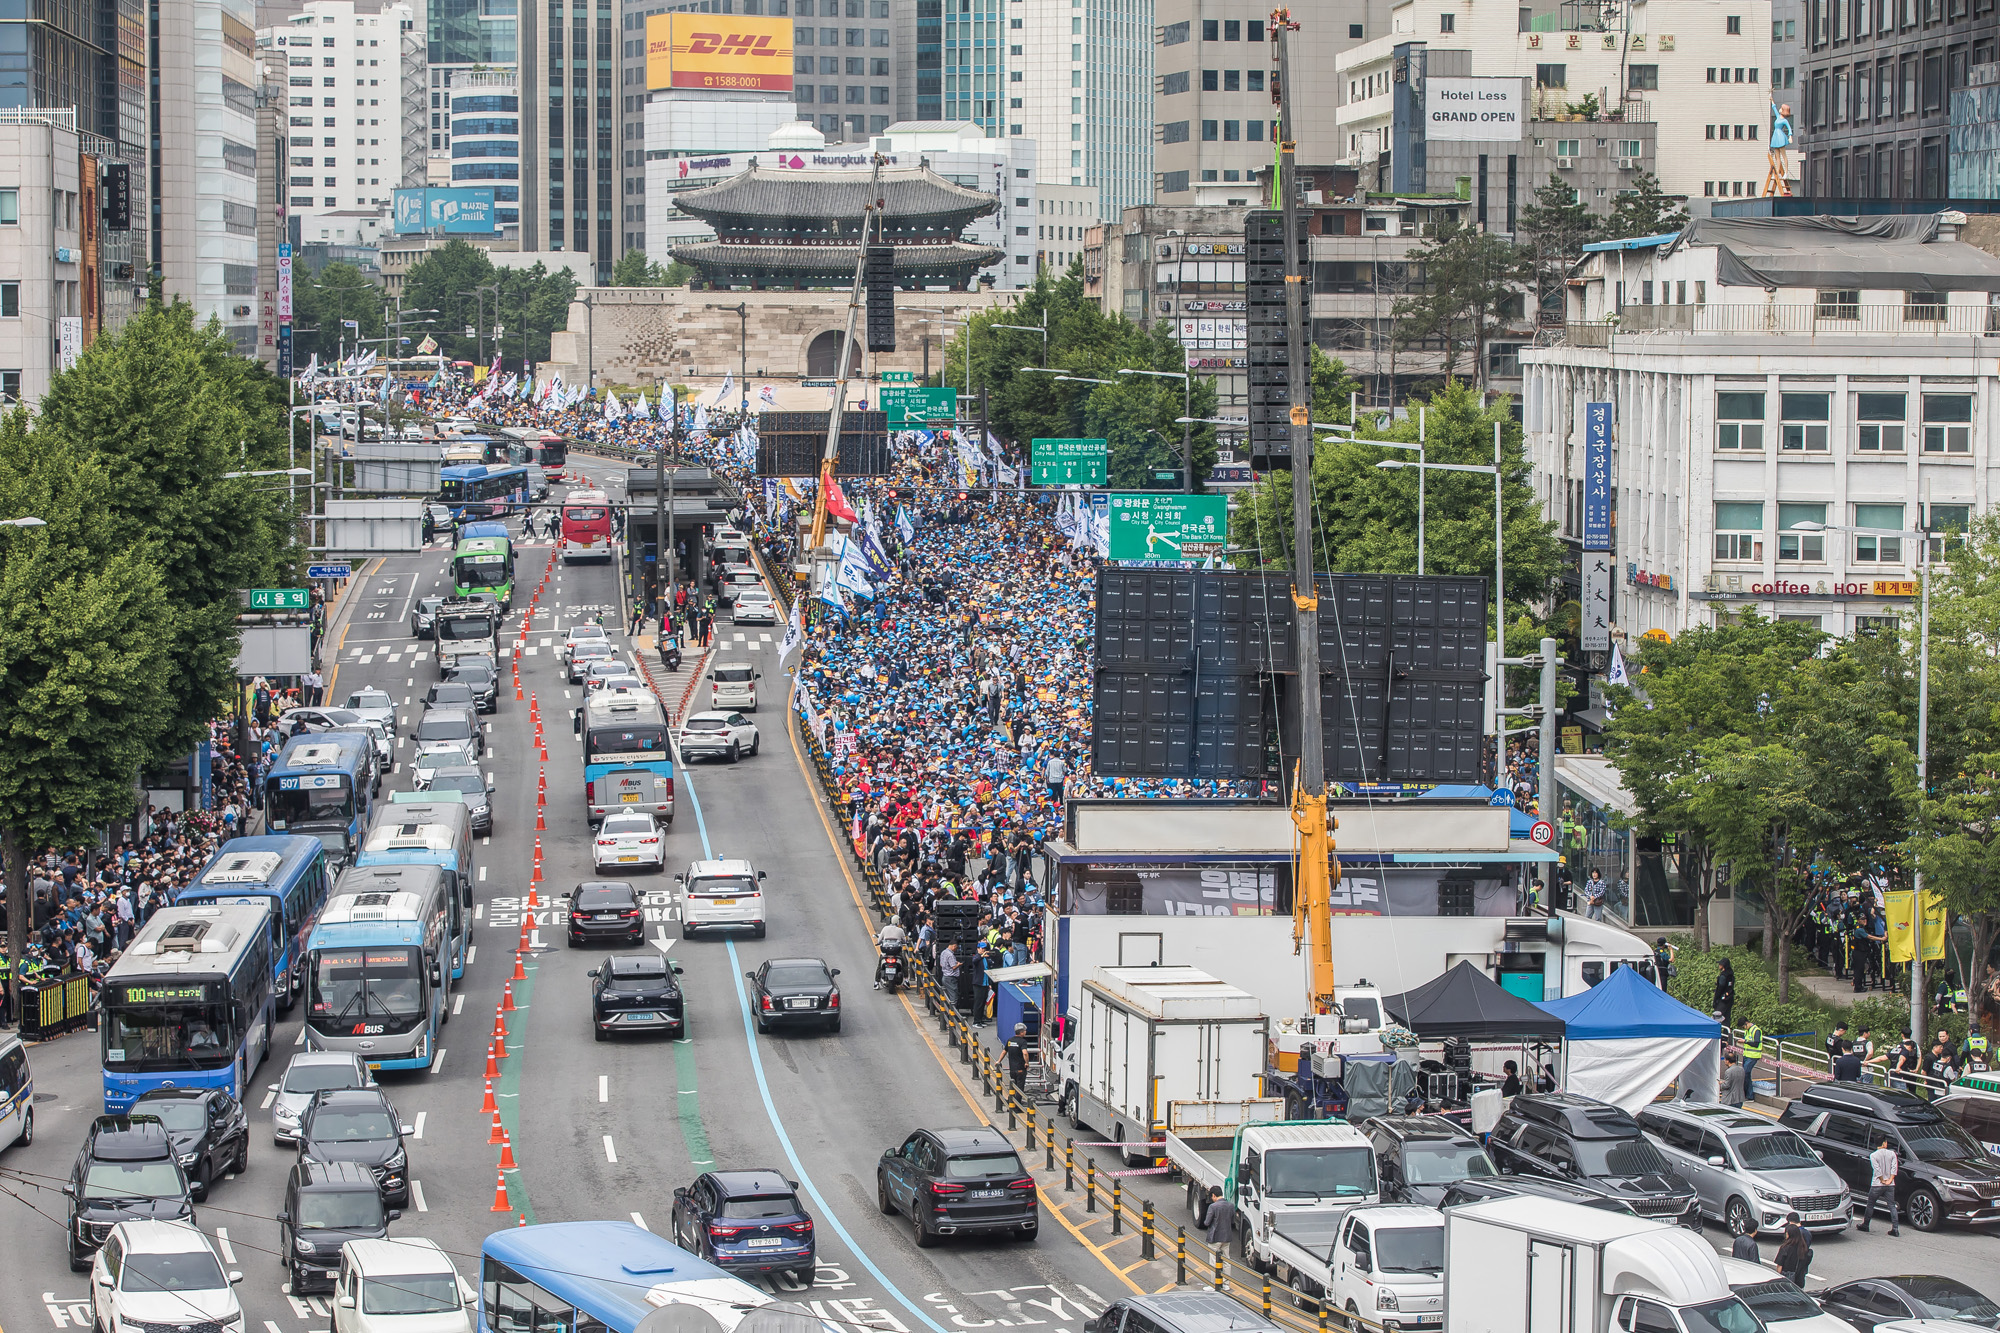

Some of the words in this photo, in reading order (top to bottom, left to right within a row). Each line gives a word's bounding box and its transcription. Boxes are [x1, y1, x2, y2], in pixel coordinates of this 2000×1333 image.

[650, 41, 667, 53] DHL
[688, 32, 777, 57] DHL
[715, 76, 761, 88] 1588-0001
[1441, 91, 1473, 100] Hotel
[1478, 91, 1507, 100] Less
[1432, 112, 1477, 122] GRAND
[1481, 112, 1515, 122] OPEN
[813, 154, 867, 166] Heungkuk
[118, 170, 127, 222] 나음피부과
[1199, 245, 1213, 254] 승리
[1213, 245, 1228, 254] 인력
[1188, 301, 1205, 311] 사교
[1207, 301, 1224, 311] 댄스
[264, 291, 273, 345] 치과재료
[1184, 324, 1193, 333] 영
[1591, 407, 1607, 500] 경일군장상사
[1124, 499, 1150, 508] 광화문
[1132, 511, 1149, 520] 시청
[1155, 511, 1182, 520] 시의회
[1181, 524, 1215, 533] 한국은행
[1702, 575, 1744, 594] 캡틴
[1751, 580, 1810, 595] coffee
[1815, 580, 1829, 595] &
[1834, 583, 1868, 595] HOF
[1875, 582, 1920, 593] 세계맥
[256, 592, 304, 605] 서울역
[280, 779, 298, 789] 507
[620, 778, 641, 787] MBUS
[1535, 827, 1549, 840] 50
[127, 988, 146, 1002] 100
[352, 1022, 384, 1034] MBUS
